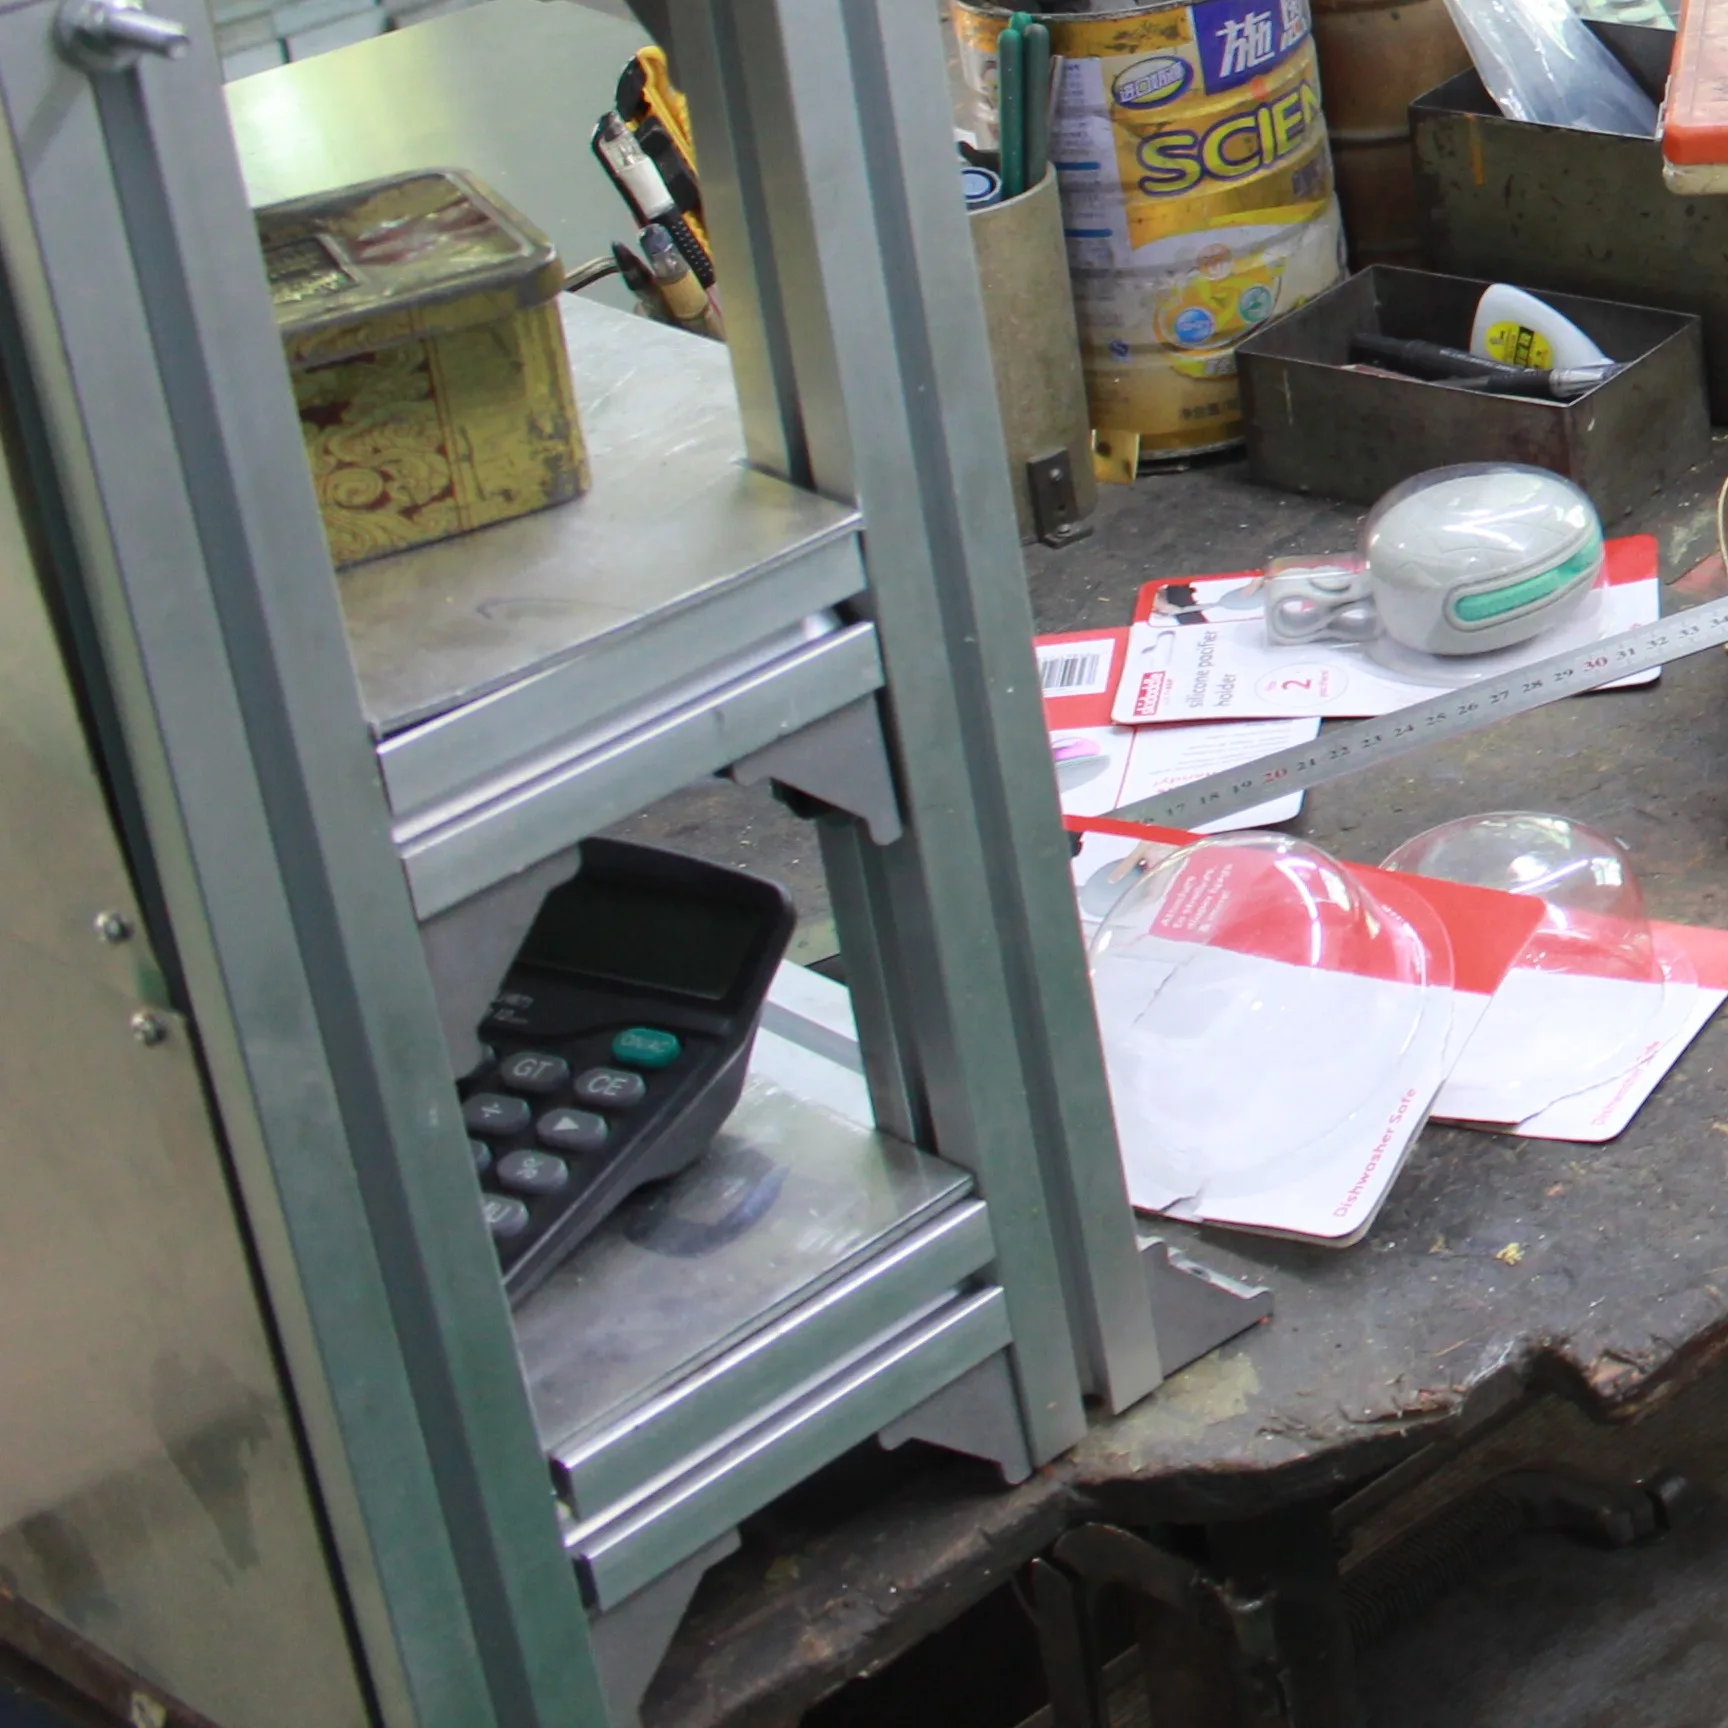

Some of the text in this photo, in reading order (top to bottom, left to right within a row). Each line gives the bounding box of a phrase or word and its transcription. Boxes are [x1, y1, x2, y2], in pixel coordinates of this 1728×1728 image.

[1186, 630, 1218, 709] silicone pacifier
[1281, 678, 1312, 691] 2
[1213, 673, 1238, 708] holder
[1264, 768, 1288, 783] 20
[1297, 758, 1316, 771] 21
[1490, 690, 1509, 704] 27
[1522, 680, 1543, 693] 28
[1554, 669, 1574, 682] 29
[1583, 657, 1608, 672] 30
[1616, 647, 1635, 661] 31
[1647, 636, 1669, 650] 32
[1679, 626, 1700, 639] 33
[513, 1058, 553, 1077] GT
[586, 1075, 627, 1096] CE
[1332, 1088, 1418, 1218] Dishwasher Safe
